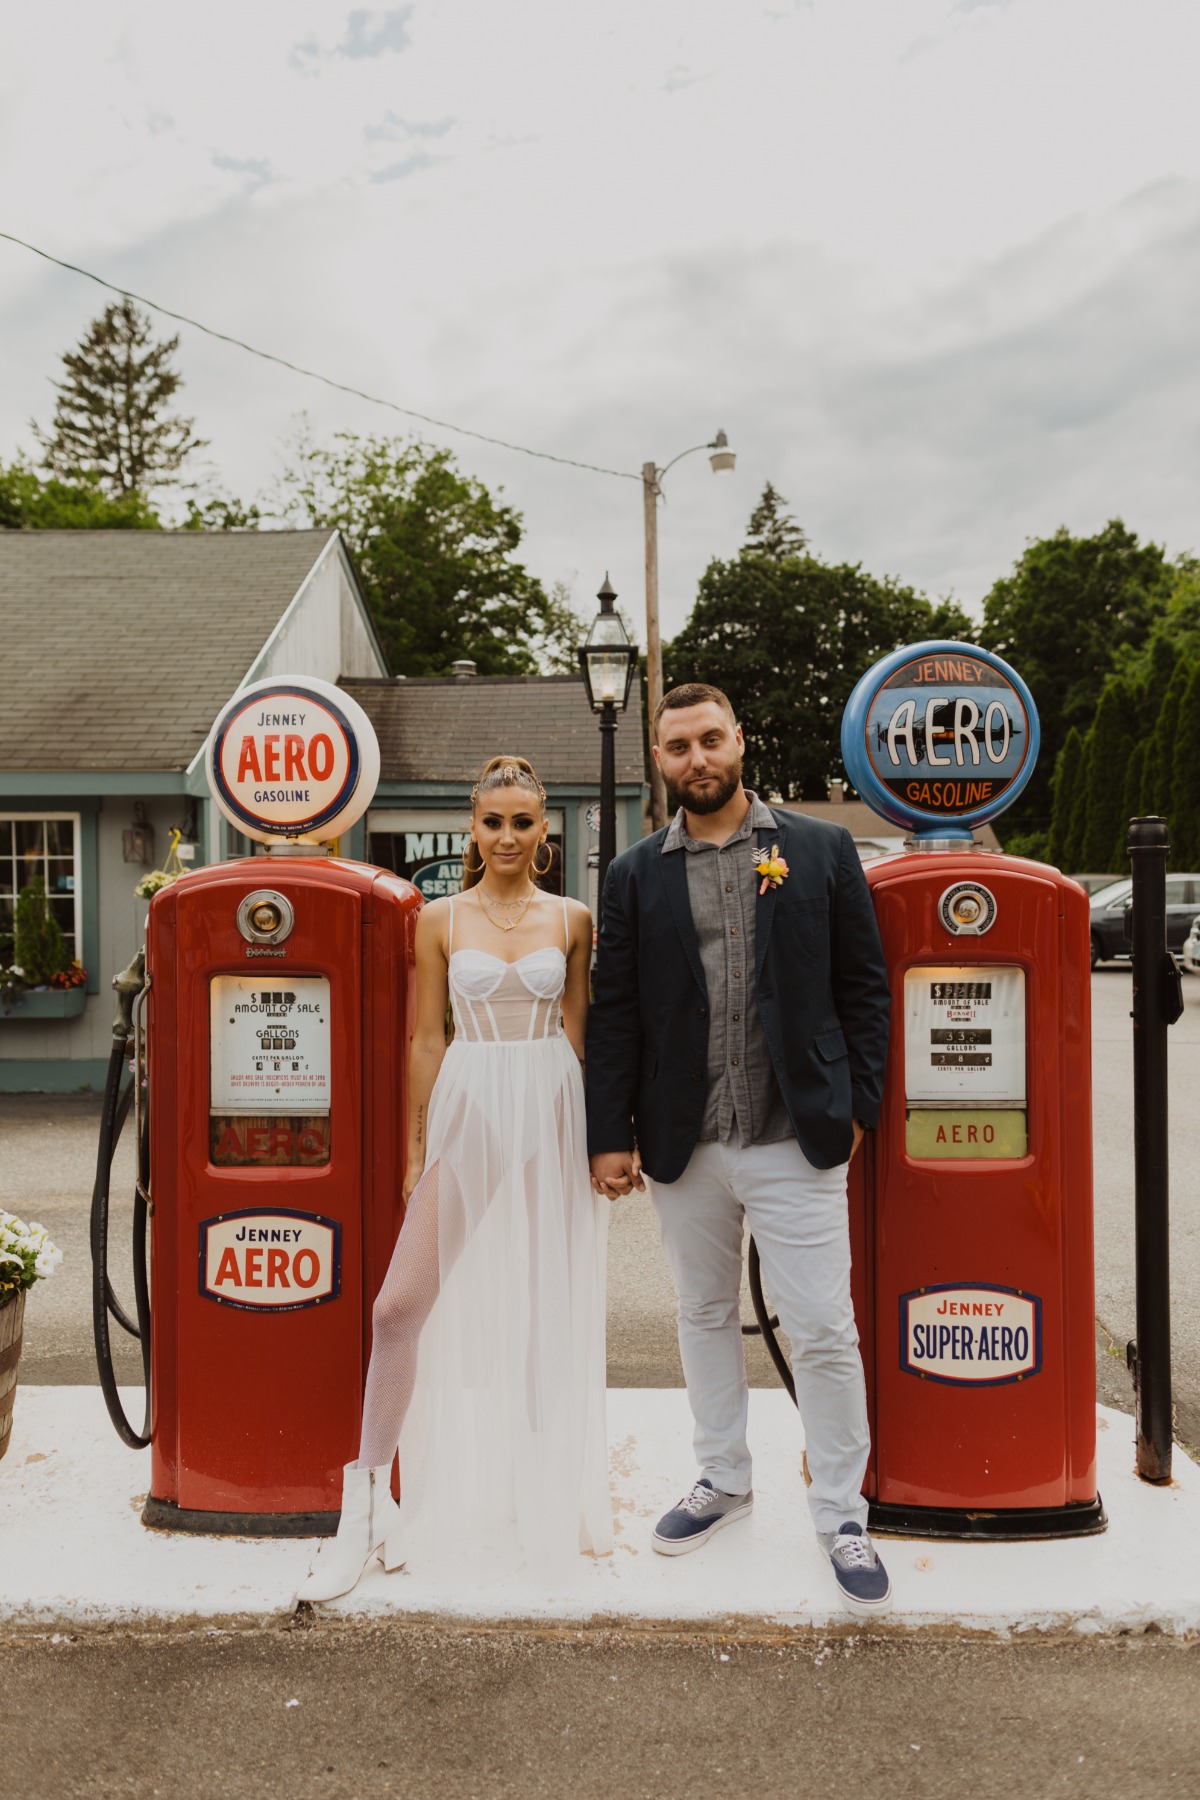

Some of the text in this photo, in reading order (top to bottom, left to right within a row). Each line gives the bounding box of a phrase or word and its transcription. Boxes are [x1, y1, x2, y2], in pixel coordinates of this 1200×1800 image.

[913, 660, 983, 683] JENNEY
[257, 712, 307, 727] JENNEY
[887, 697, 1011, 767] AERO
[236, 732, 335, 783] AERO
[254, 789, 311, 803] GASOLINE
[907, 781, 993, 807] GASOLINE
[251, 992, 257, 1004] $
[234, 1004, 320, 1013] AMOUNT OF SALE
[255, 1029, 300, 1038] GALLONS
[215, 1127, 325, 1157] AERO
[936, 1124, 995, 1144] AERO
[236, 1225, 302, 1243] JENNEY
[214, 1246, 321, 1289] AERO
[936, 1299, 1005, 1317] JENNEY
